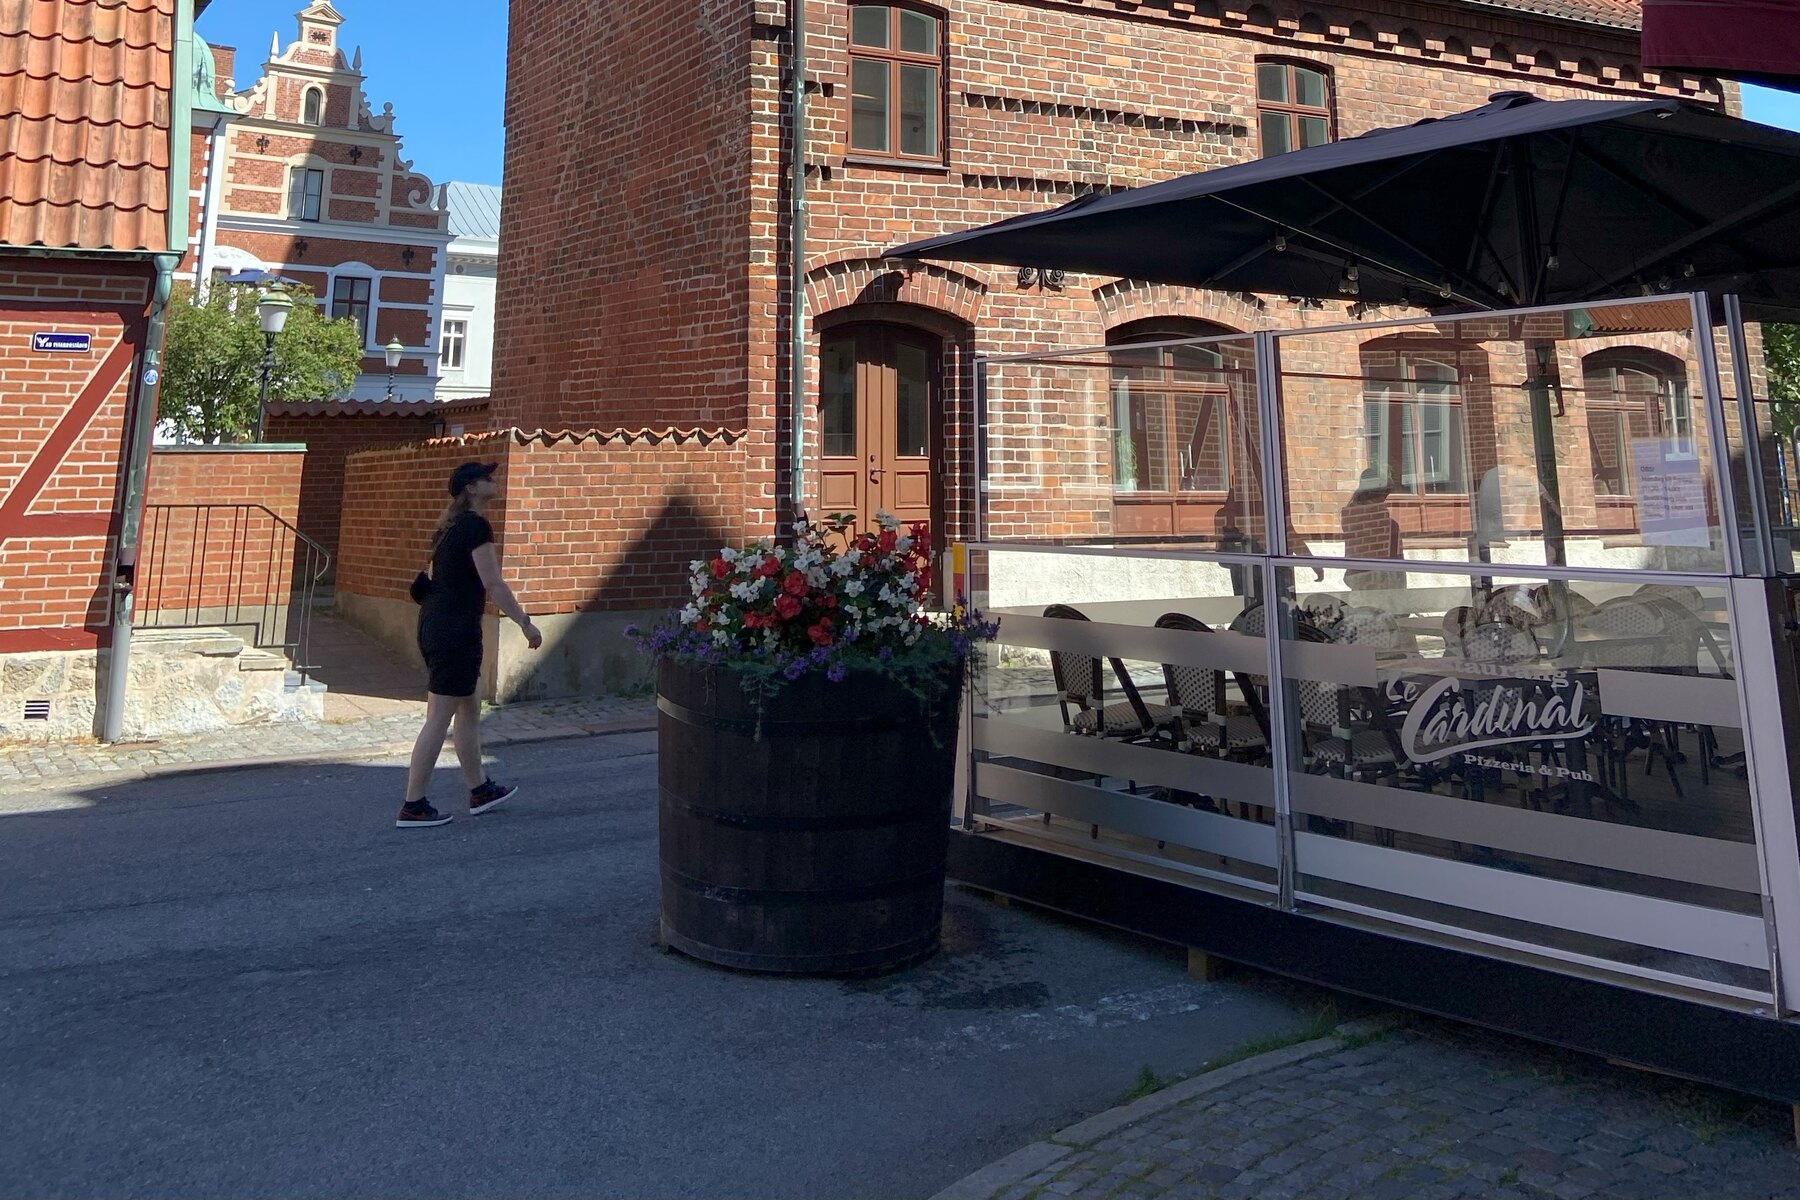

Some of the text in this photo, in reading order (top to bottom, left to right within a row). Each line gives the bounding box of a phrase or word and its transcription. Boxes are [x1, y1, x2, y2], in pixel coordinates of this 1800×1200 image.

[1406, 652, 1570, 689] Rtaurang
[1401, 677, 1597, 763] Cardinal
[1463, 754, 1593, 781] Pizzeria & Pub
